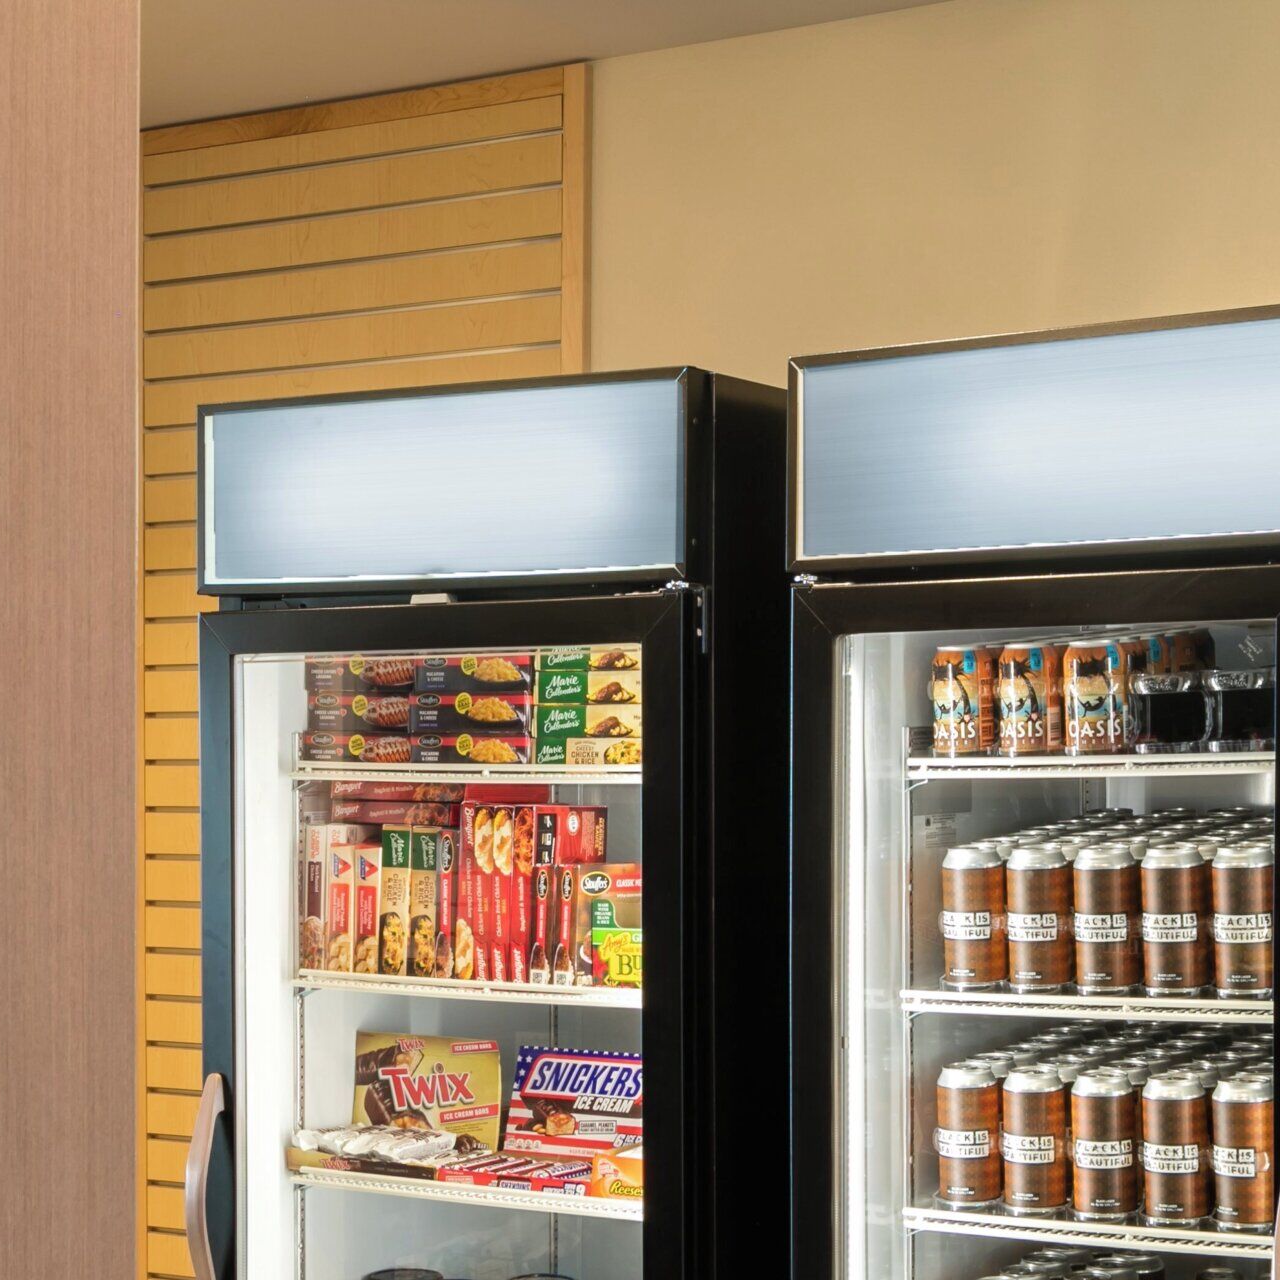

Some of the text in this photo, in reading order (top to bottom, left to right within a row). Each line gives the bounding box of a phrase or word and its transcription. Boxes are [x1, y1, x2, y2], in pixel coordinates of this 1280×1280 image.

[546, 675, 579, 689] Marie
[544, 709, 577, 723] Marie
[978, 914, 988, 924] IS
[1045, 915, 1055, 924] IS
[1115, 915, 1125, 924] IS
[1185, 915, 1195, 925] IS
[530, 1061, 643, 1099] SNICKERS
[379, 1062, 475, 1112] Twix
[573, 1096, 635, 1114] ICE CREAM
[454, 1111, 474, 1119] CREAM
[474, 1108, 490, 1116] BARS
[977, 1131, 987, 1140] IS
[1043, 1137, 1052, 1147] IS
